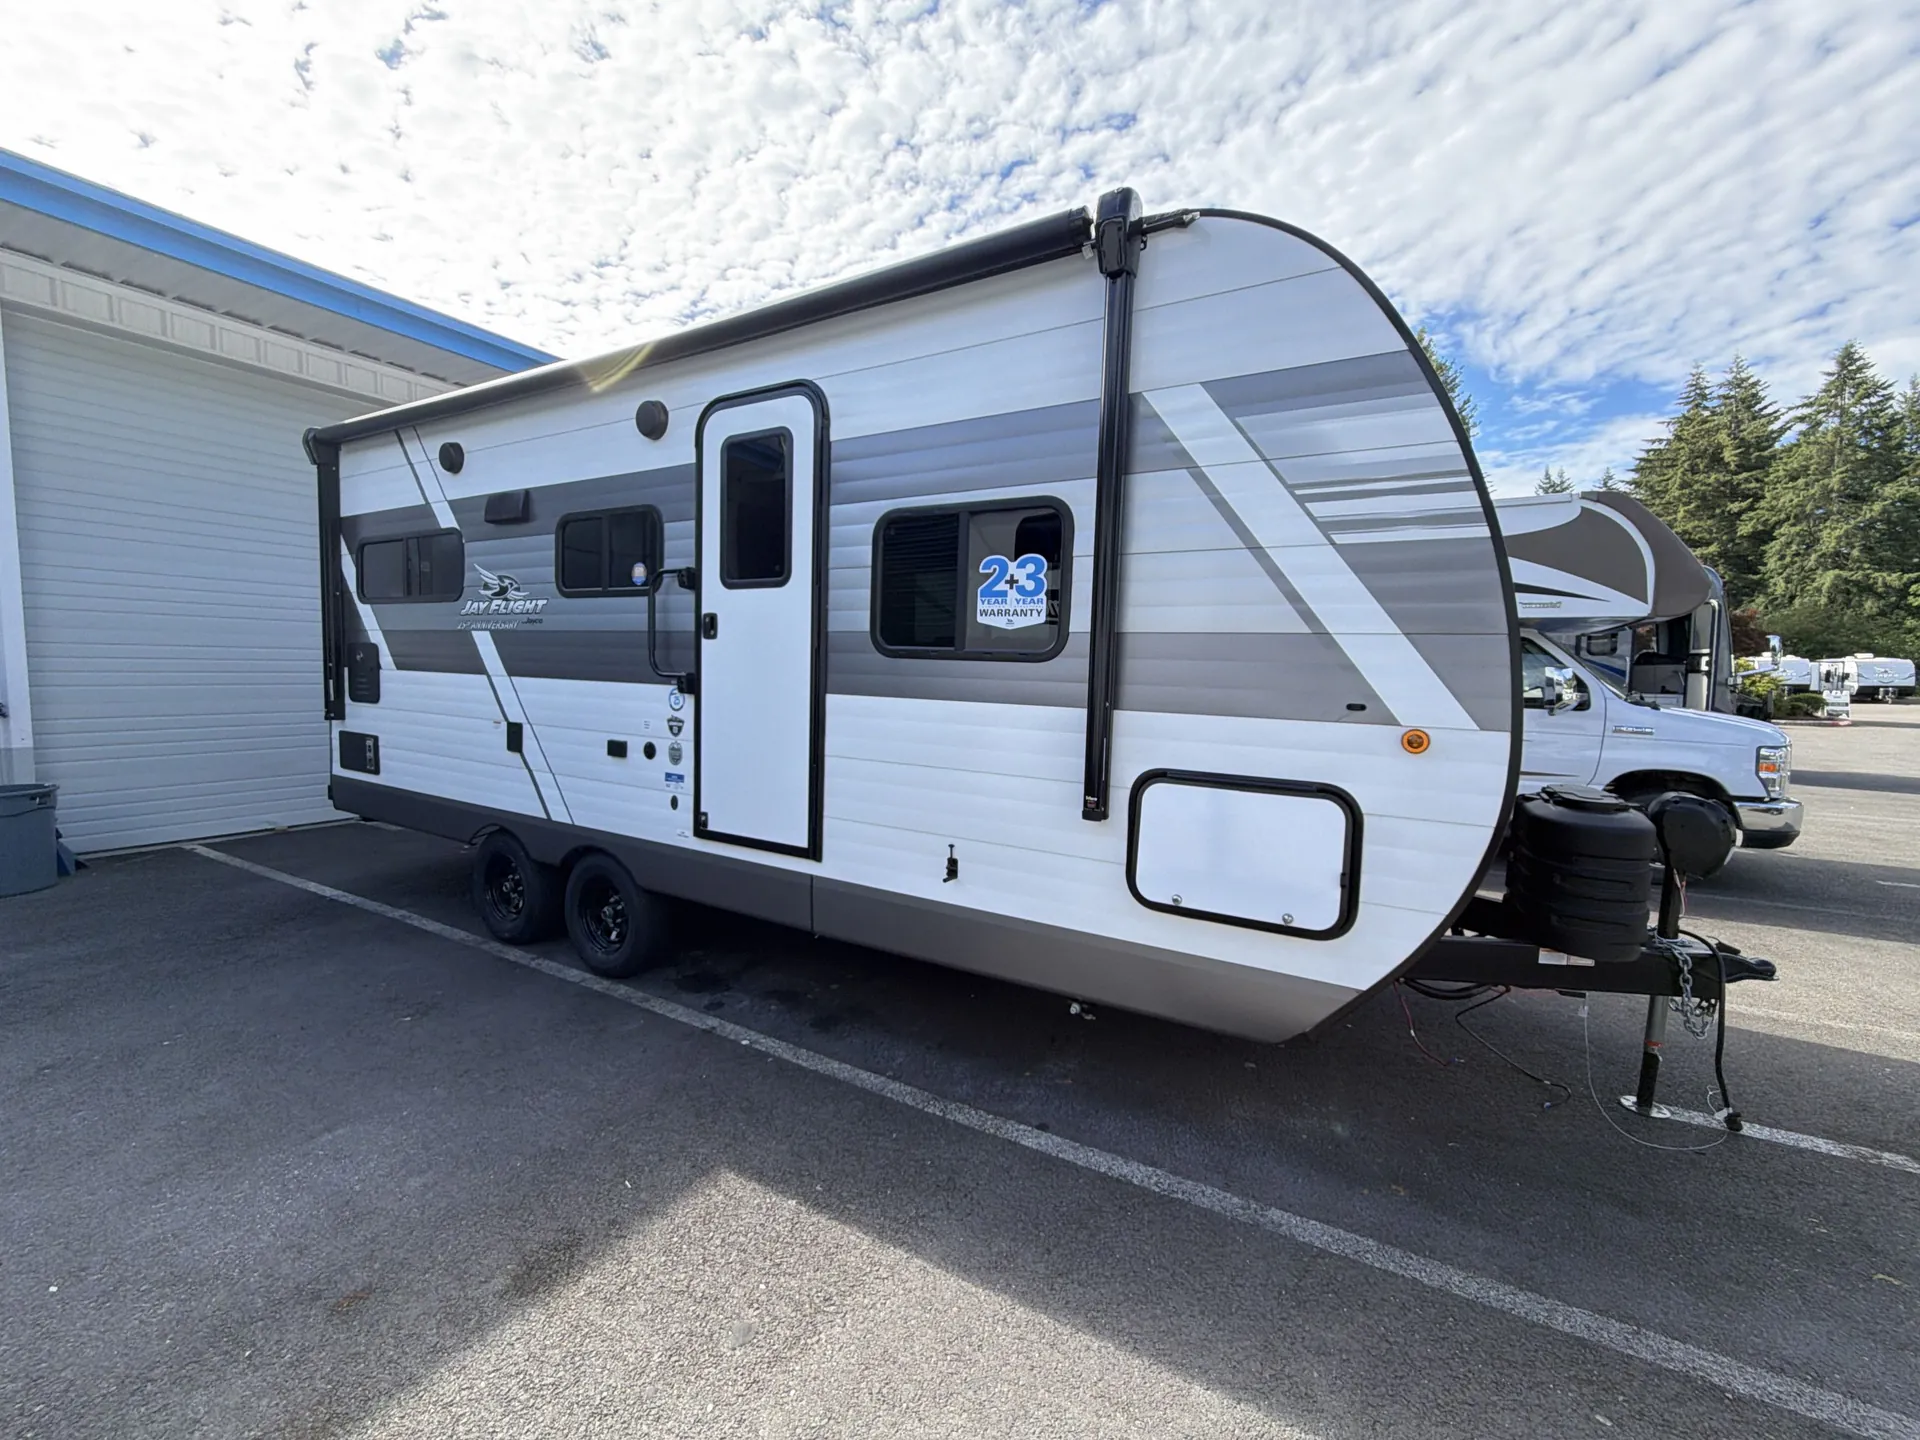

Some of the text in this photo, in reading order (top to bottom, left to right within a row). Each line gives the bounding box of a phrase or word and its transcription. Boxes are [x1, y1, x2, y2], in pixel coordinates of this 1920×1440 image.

[980, 597, 1044, 606] YEAR YEAR
[460, 599, 549, 616] JAY FLIGHT
[979, 608, 1043, 618] WARRANTY
[471, 620, 519, 631] ANNIVERSARY
